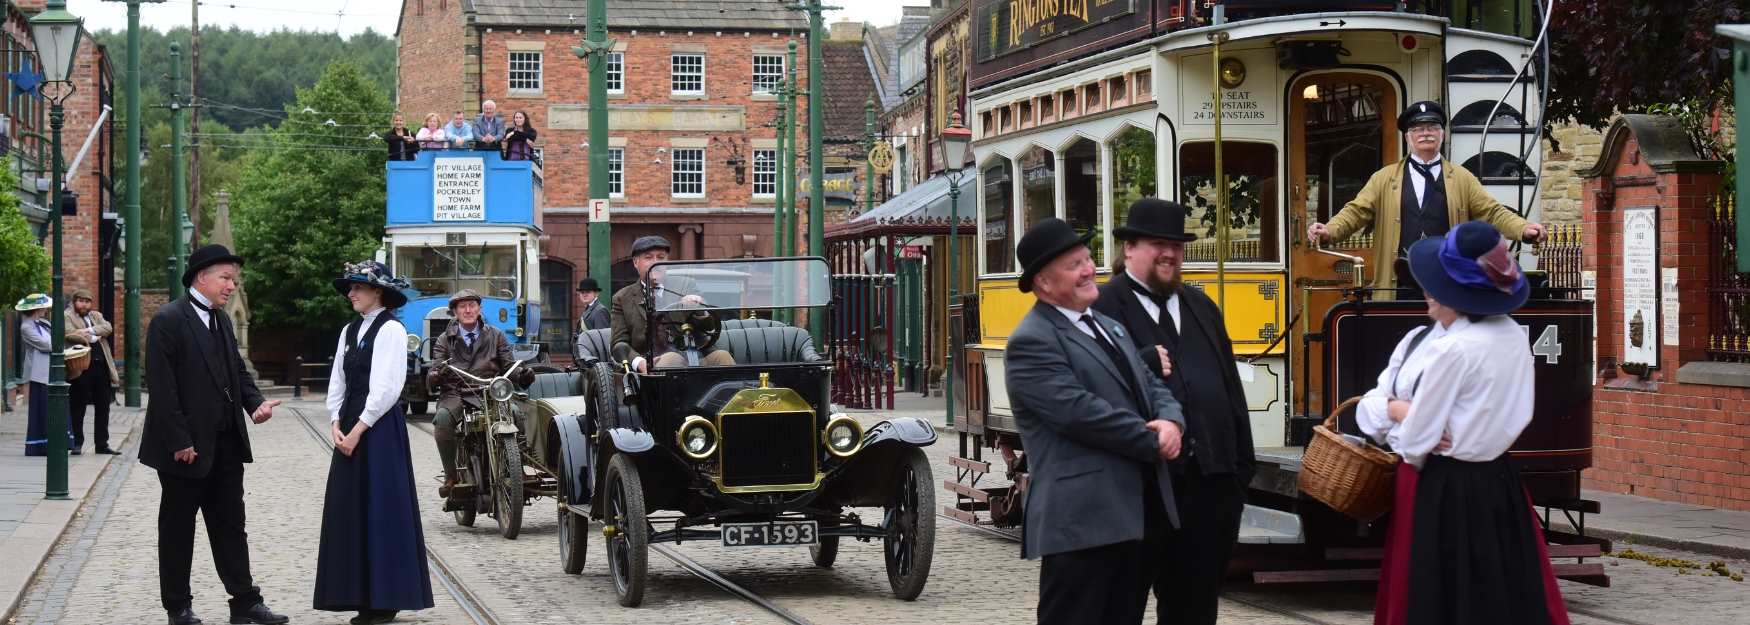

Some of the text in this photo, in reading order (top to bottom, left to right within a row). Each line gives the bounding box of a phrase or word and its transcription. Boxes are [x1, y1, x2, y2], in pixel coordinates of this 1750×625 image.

[1226, 91, 1250, 100] SEAT
[1202, 101, 1257, 110] 29 PSTAIRS
[1193, 111, 1204, 120] 24
[595, 201, 604, 220] F
